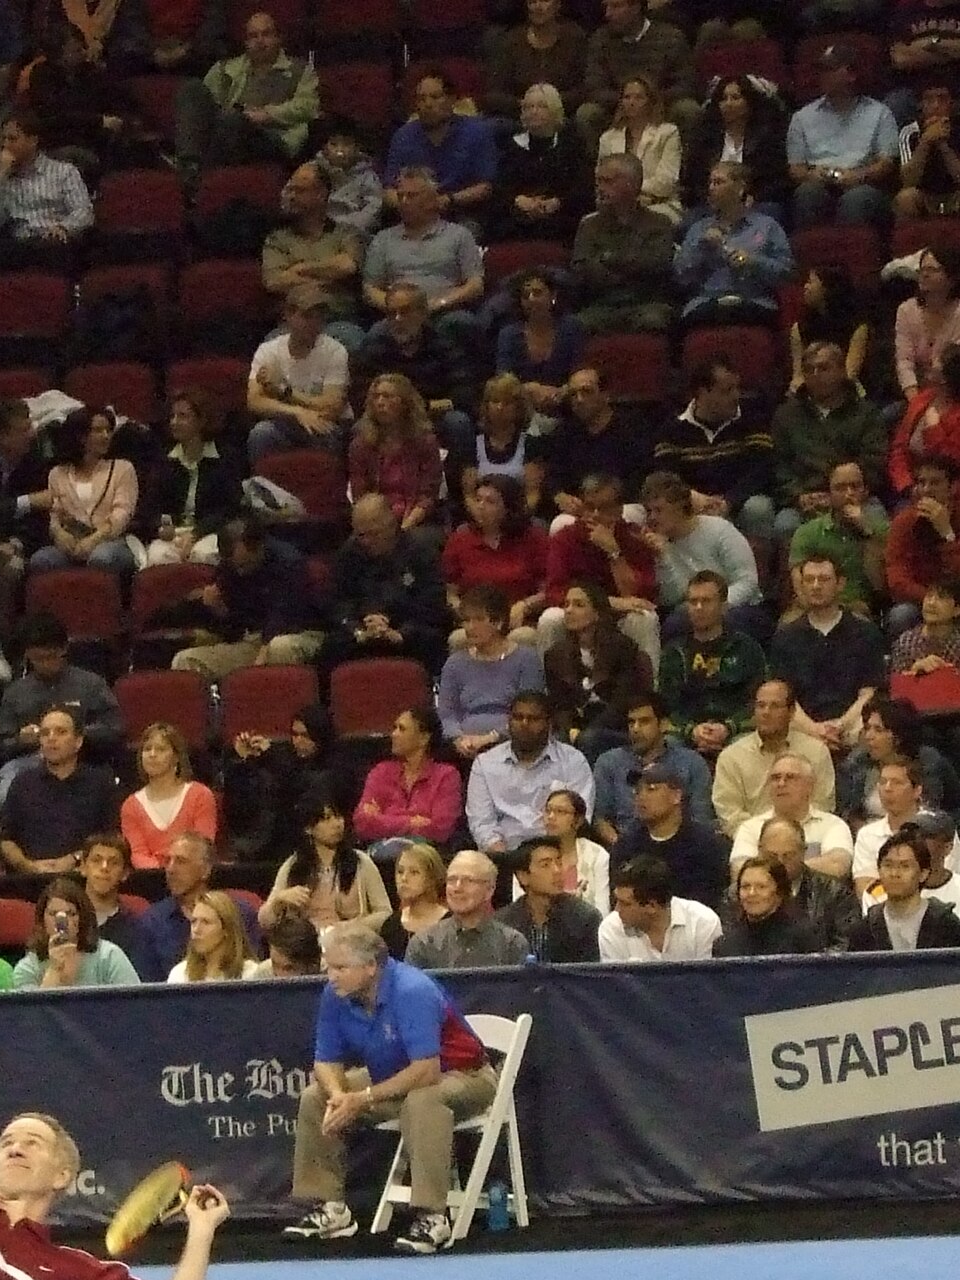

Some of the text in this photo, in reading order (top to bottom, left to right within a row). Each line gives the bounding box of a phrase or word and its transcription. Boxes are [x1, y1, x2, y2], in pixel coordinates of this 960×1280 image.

[160, 1057, 317, 1107] The Bo
[208, 1115, 256, 1138] The
[876, 1131, 947, 1167] that
